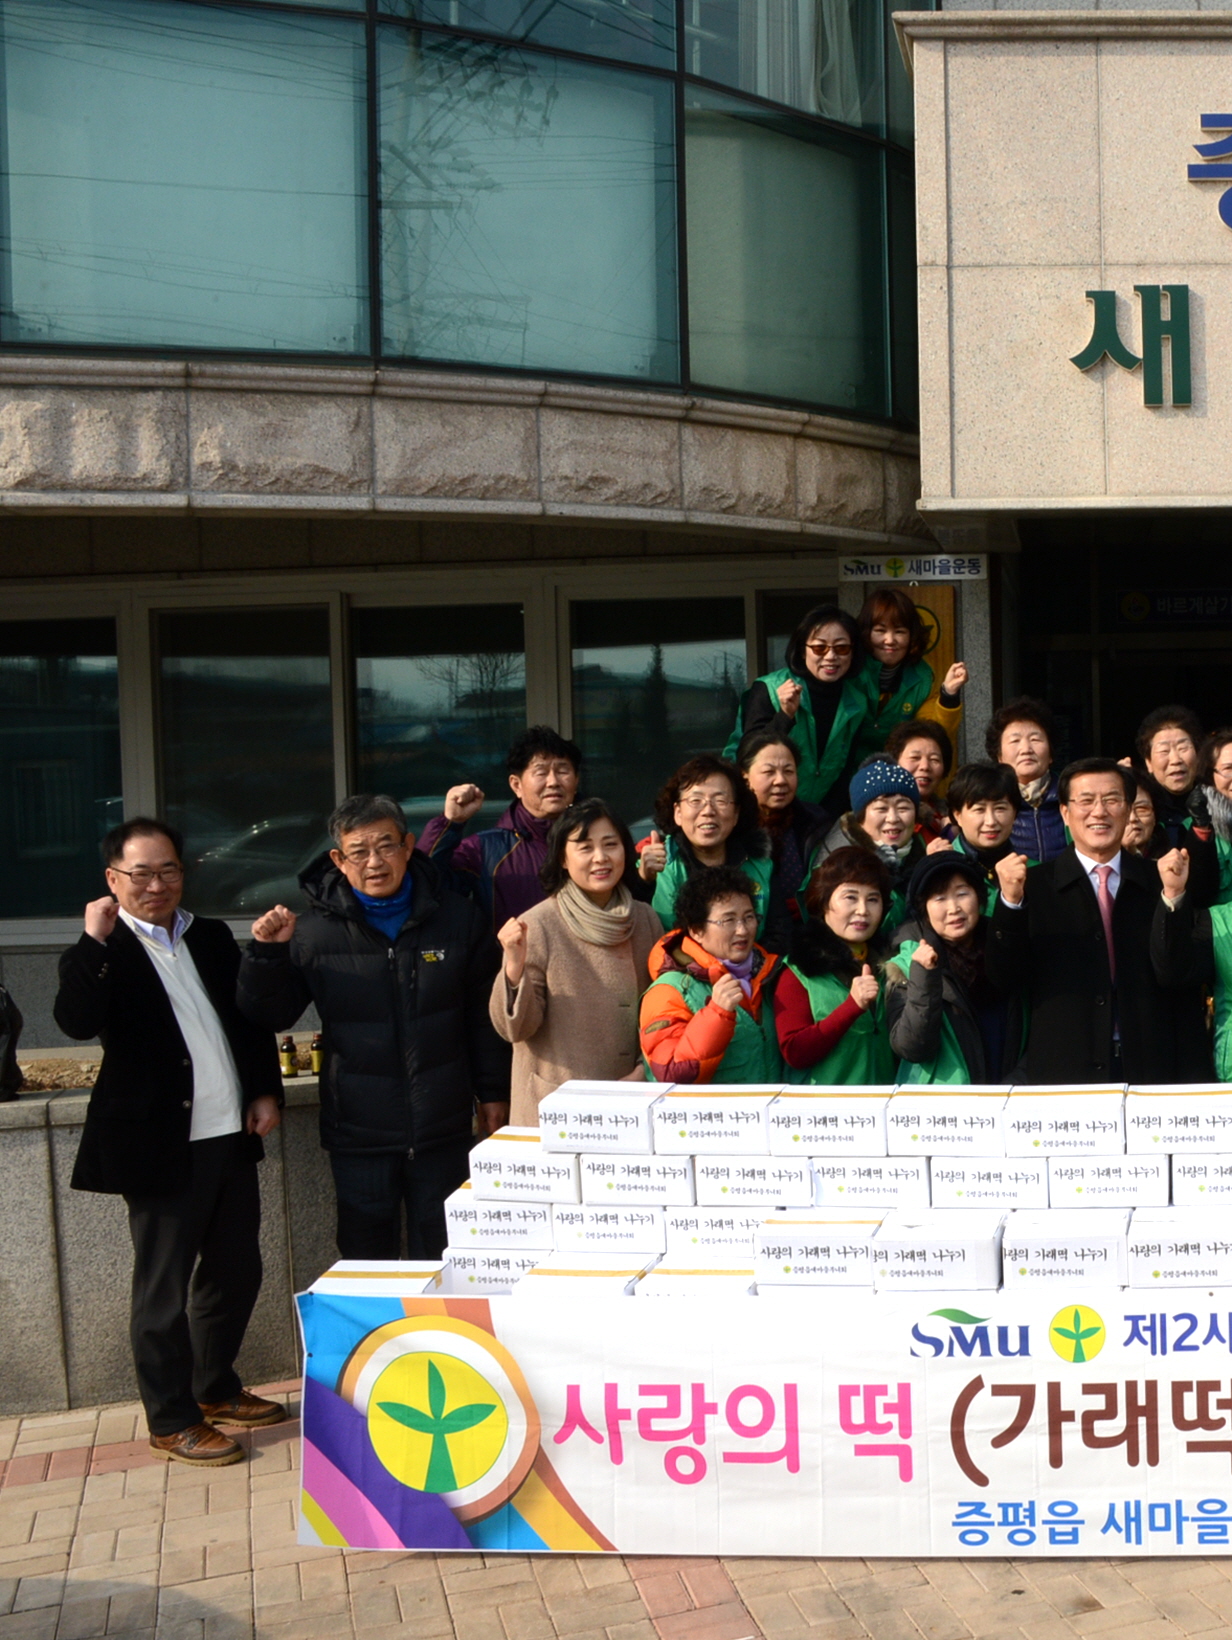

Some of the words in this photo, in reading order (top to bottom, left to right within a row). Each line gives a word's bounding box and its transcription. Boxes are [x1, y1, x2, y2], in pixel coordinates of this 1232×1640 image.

[908, 558, 982, 575] 새마을운동
[539, 1112, 567, 1126] 사랑의
[573, 1114, 603, 1126] 가래떡
[608, 1115, 639, 1127] 나누기
[657, 1112, 687, 1124] 사랑의
[693, 1112, 723, 1123] 가래떡
[729, 1111, 760, 1123] 나누기
[770, 1116, 801, 1128] 사랑의
[807, 1116, 838, 1128] 가래떡
[844, 1117, 875, 1128] 나누기
[890, 1115, 920, 1127] 사랑의
[926, 1116, 957, 1128] 가래떡
[964, 1117, 994, 1128] 나누기
[1130, 1116, 1161, 1128] 사랑의
[1168, 1116, 1199, 1128] 가래떡
[1011, 1121, 1042, 1133] 사랑의
[1048, 1121, 1080, 1132] 가래떡
[1086, 1121, 1117, 1133] 나누기
[473, 1161, 502, 1174] 사랑의
[507, 1164, 536, 1177] 가래떡
[541, 1166, 570, 1179] 나누기
[586, 1162, 615, 1175] 사랑의
[621, 1165, 651, 1178] 가래떡
[656, 1167, 687, 1179] 나누기
[700, 1167, 729, 1179] 사랑의
[736, 1168, 766, 1181] 가래떡
[772, 1170, 802, 1181] 나누기
[814, 1167, 846, 1179] 사랑의
[852, 1168, 883, 1179] 가래떡
[888, 1168, 919, 1180] 나누기
[1054, 1168, 1084, 1180] 사랑의
[1091, 1167, 1121, 1178] 가래떡
[1128, 1167, 1159, 1178] 나누기
[1177, 1166, 1207, 1178] 사랑의
[935, 1170, 965, 1183] 사랑의
[971, 1171, 1003, 1183] 가래떡
[1008, 1172, 1040, 1184] 나누기
[449, 1210, 477, 1222] 사랑의
[482, 1210, 512, 1222] 가래떡
[517, 1210, 546, 1222] 나누기
[556, 1213, 584, 1225] 사랑의
[589, 1213, 619, 1225] 가래떡
[624, 1214, 654, 1225] 나누기
[670, 1219, 698, 1231] 사랑의
[705, 1219, 734, 1230] 가래떡
[740, 1219, 765, 1230] 나누
[761, 1246, 792, 1259] 사랑의
[798, 1246, 830, 1258] 가래떡
[834, 1246, 869, 1258] 나누기
[895, 1250, 926, 1262] 가래떡
[933, 1250, 965, 1262] 나누기
[1034, 1248, 1068, 1261] 가래떡
[1073, 1248, 1107, 1261] 나누기
[1129, 1244, 1161, 1257] 사랑의
[1168, 1243, 1200, 1255] 가래떡
[481, 1258, 510, 1270] 가래떡
[553, 1381, 800, 1485] 사랑의
[839, 1381, 913, 1482] 떡
[951, 1500, 1085, 1546] 증평읍
